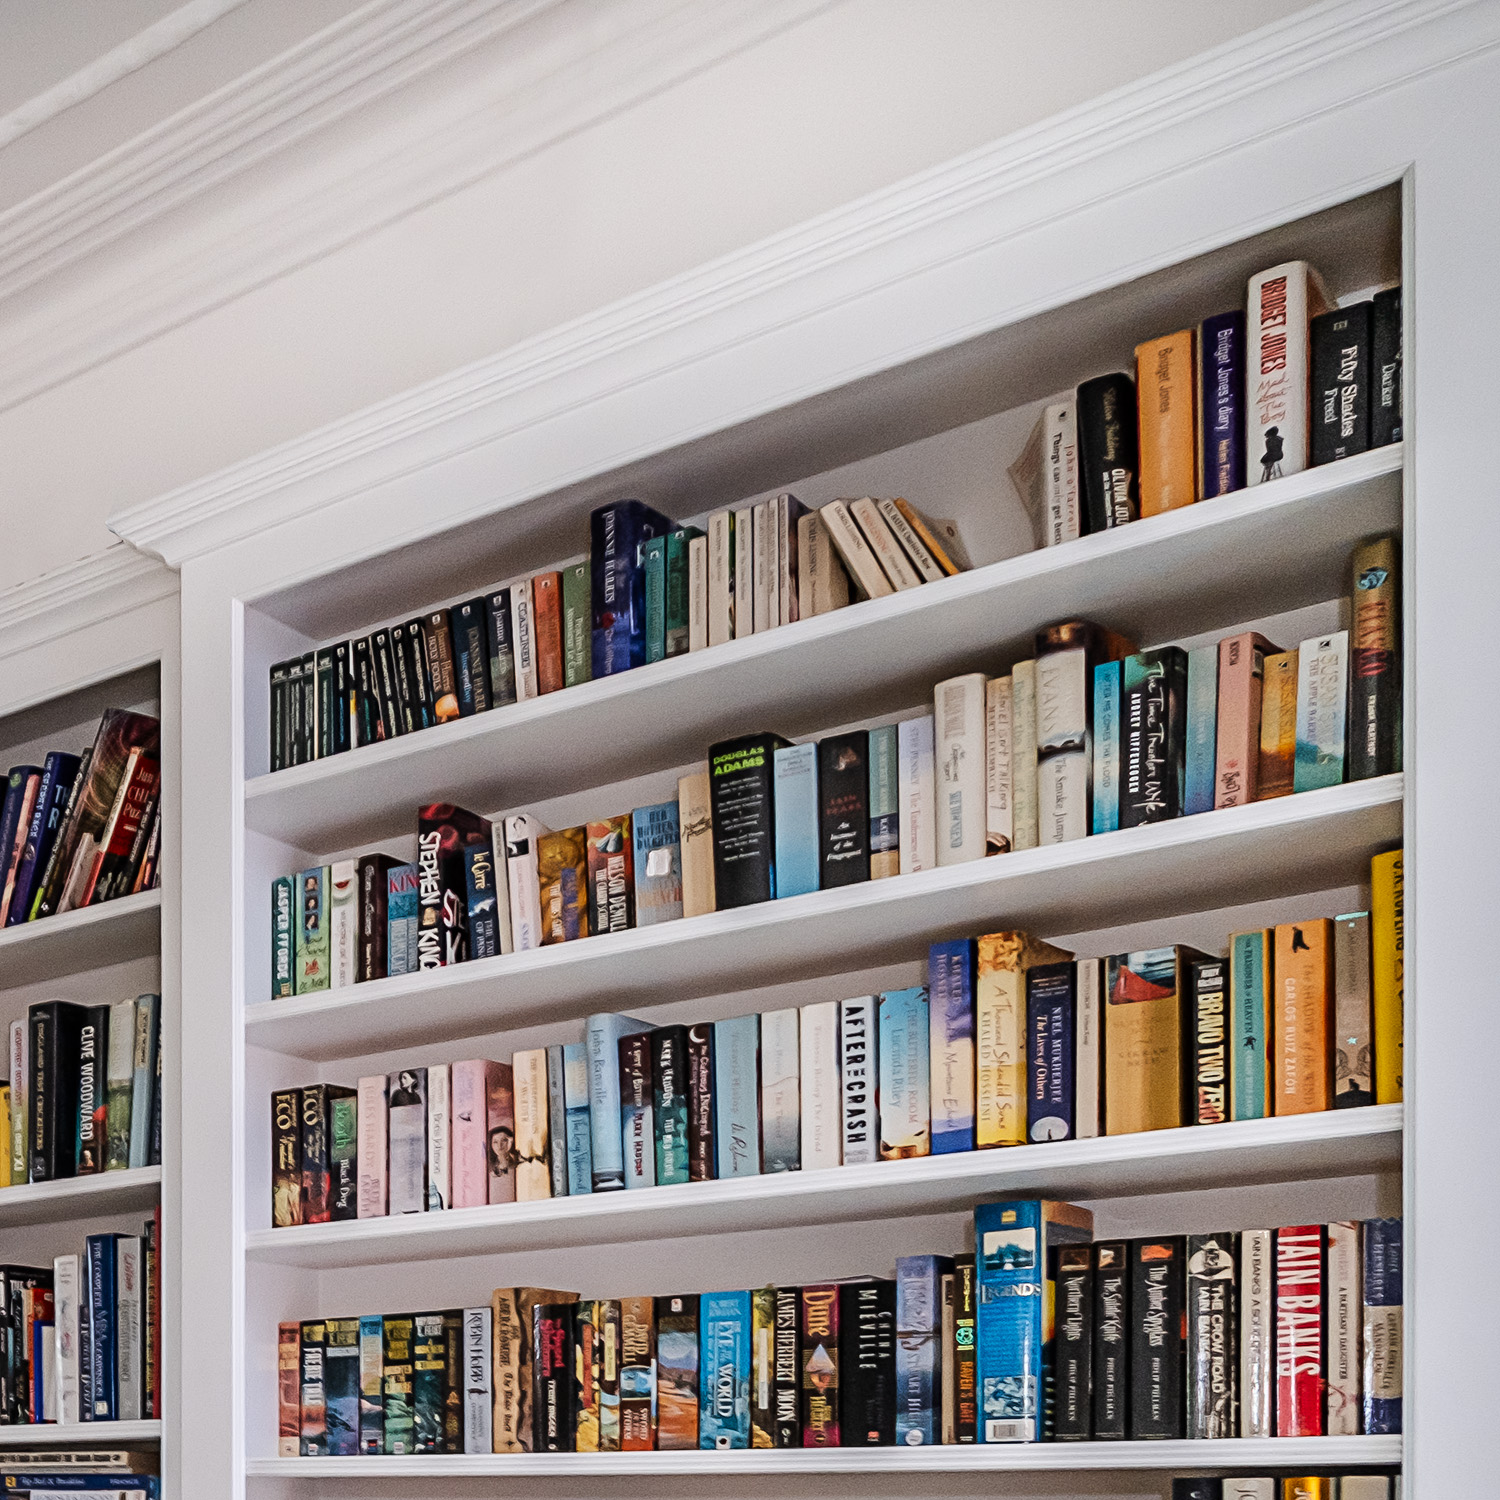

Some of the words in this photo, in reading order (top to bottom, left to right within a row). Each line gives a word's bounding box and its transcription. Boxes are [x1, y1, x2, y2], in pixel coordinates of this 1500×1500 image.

[1261, 276, 1287, 331] BRIDGET
[1216, 328, 1233, 365] Bridget
[1261, 333, 1287, 374] JONES
[1338, 345, 1358, 381] Fifty
[1158, 347, 1173, 383] Bridget
[1159, 385, 1173, 413] Jones
[1217, 367, 1234, 403] Jones's
[1381, 363, 1396, 407] Darker
[1215, 406, 1233, 431] diary
[1324, 388, 1338, 424] Freed
[1341, 385, 1357, 437] Shades
[603, 510, 616, 556] JOANNE
[604, 560, 616, 603] HARRIS
[494, 609, 506, 641] Joanne
[497, 644, 510, 674] Harris
[713, 746, 765, 764] DOUGLAS
[714, 756, 765, 775] ADAMS
[419, 831, 441, 904] STEPHEN
[418, 928, 438, 971] KING
[1197, 992, 1224, 1044] BRAVO
[1284, 978, 1297, 1022] CARLOS
[80, 1025, 95, 1059] CLIVE
[661, 1039, 673, 1067] MARK
[846, 1006, 866, 1064] AFTER
[1284, 1026, 1297, 1053] RUIZ
[1198, 1044, 1225, 1083] TWO
[79, 1062, 95, 1140] WOODWARD
[661, 1068, 674, 1107] HADDON
[1198, 1084, 1225, 1124] ZERO
[276, 1095, 292, 1130] ECO
[303, 1089, 320, 1126] ECO
[846, 1082, 867, 1143] CRASH
[340, 1158, 351, 1185] Black
[336, 1187, 351, 1208] Dog
[1252, 1236, 1261, 1257] IAIN
[1277, 1235, 1320, 1285] IAIN
[981, 1281, 1042, 1305] LEGENDS
[1066, 1276, 1084, 1313] Northern
[1252, 1259, 1261, 1295] BANKS
[777, 1291, 795, 1327] JAMES
[803, 1290, 837, 1337] Dune
[1211, 1285, 1223, 1310] THE
[470, 1312, 483, 1346] ROBIN
[622, 1314, 637, 1364] GEMMELL
[636, 1324, 649, 1355] DAVID
[718, 1321, 733, 1348] EYE
[878, 1311, 891, 1358] CHINA
[1066, 1317, 1084, 1341] Lights
[1211, 1315, 1224, 1353] CROW
[1277, 1295, 1320, 1377] BANKS
[471, 1349, 483, 1383] HOBB
[777, 1330, 796, 1383] HERBERT
[718, 1363, 734, 1417] WORLD
[1212, 1357, 1224, 1393] ROAD
[777, 1389, 795, 1421] MOON
